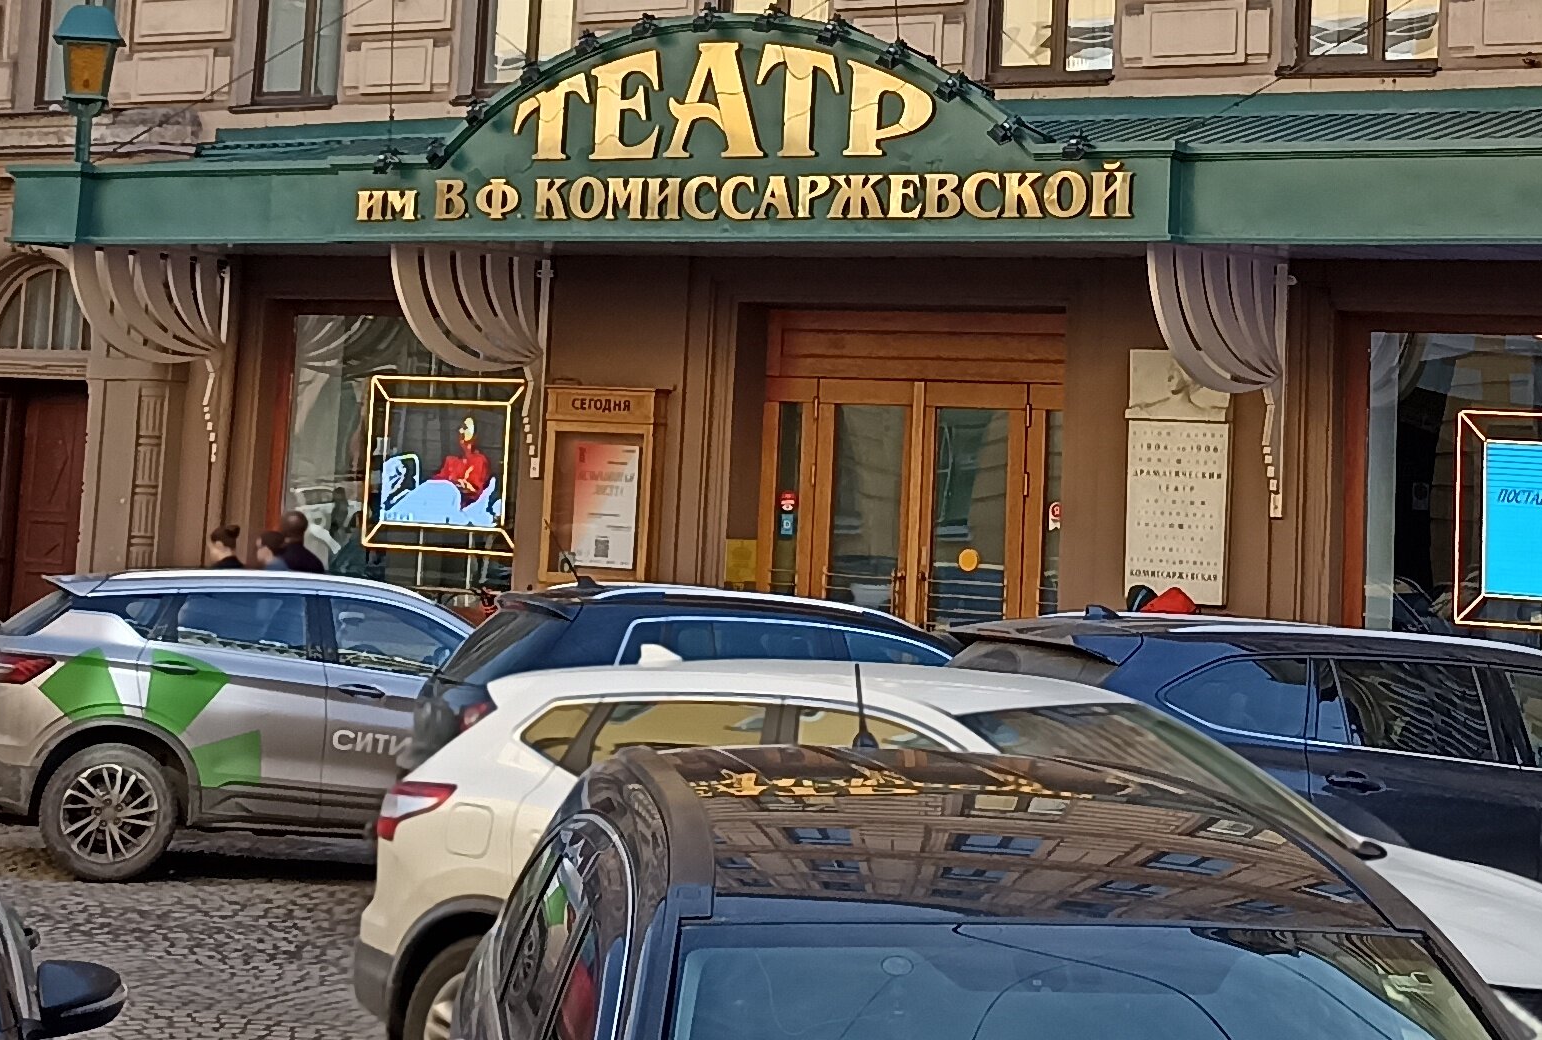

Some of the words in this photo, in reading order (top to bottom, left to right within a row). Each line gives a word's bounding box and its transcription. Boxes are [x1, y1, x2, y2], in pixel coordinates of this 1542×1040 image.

[512, 42, 937, 160] ТЕАТР
[534, 161, 1136, 221] КОМИССАРЖЕВСКОЙ
[571, 397, 631, 413] СЕГОДНЯ
